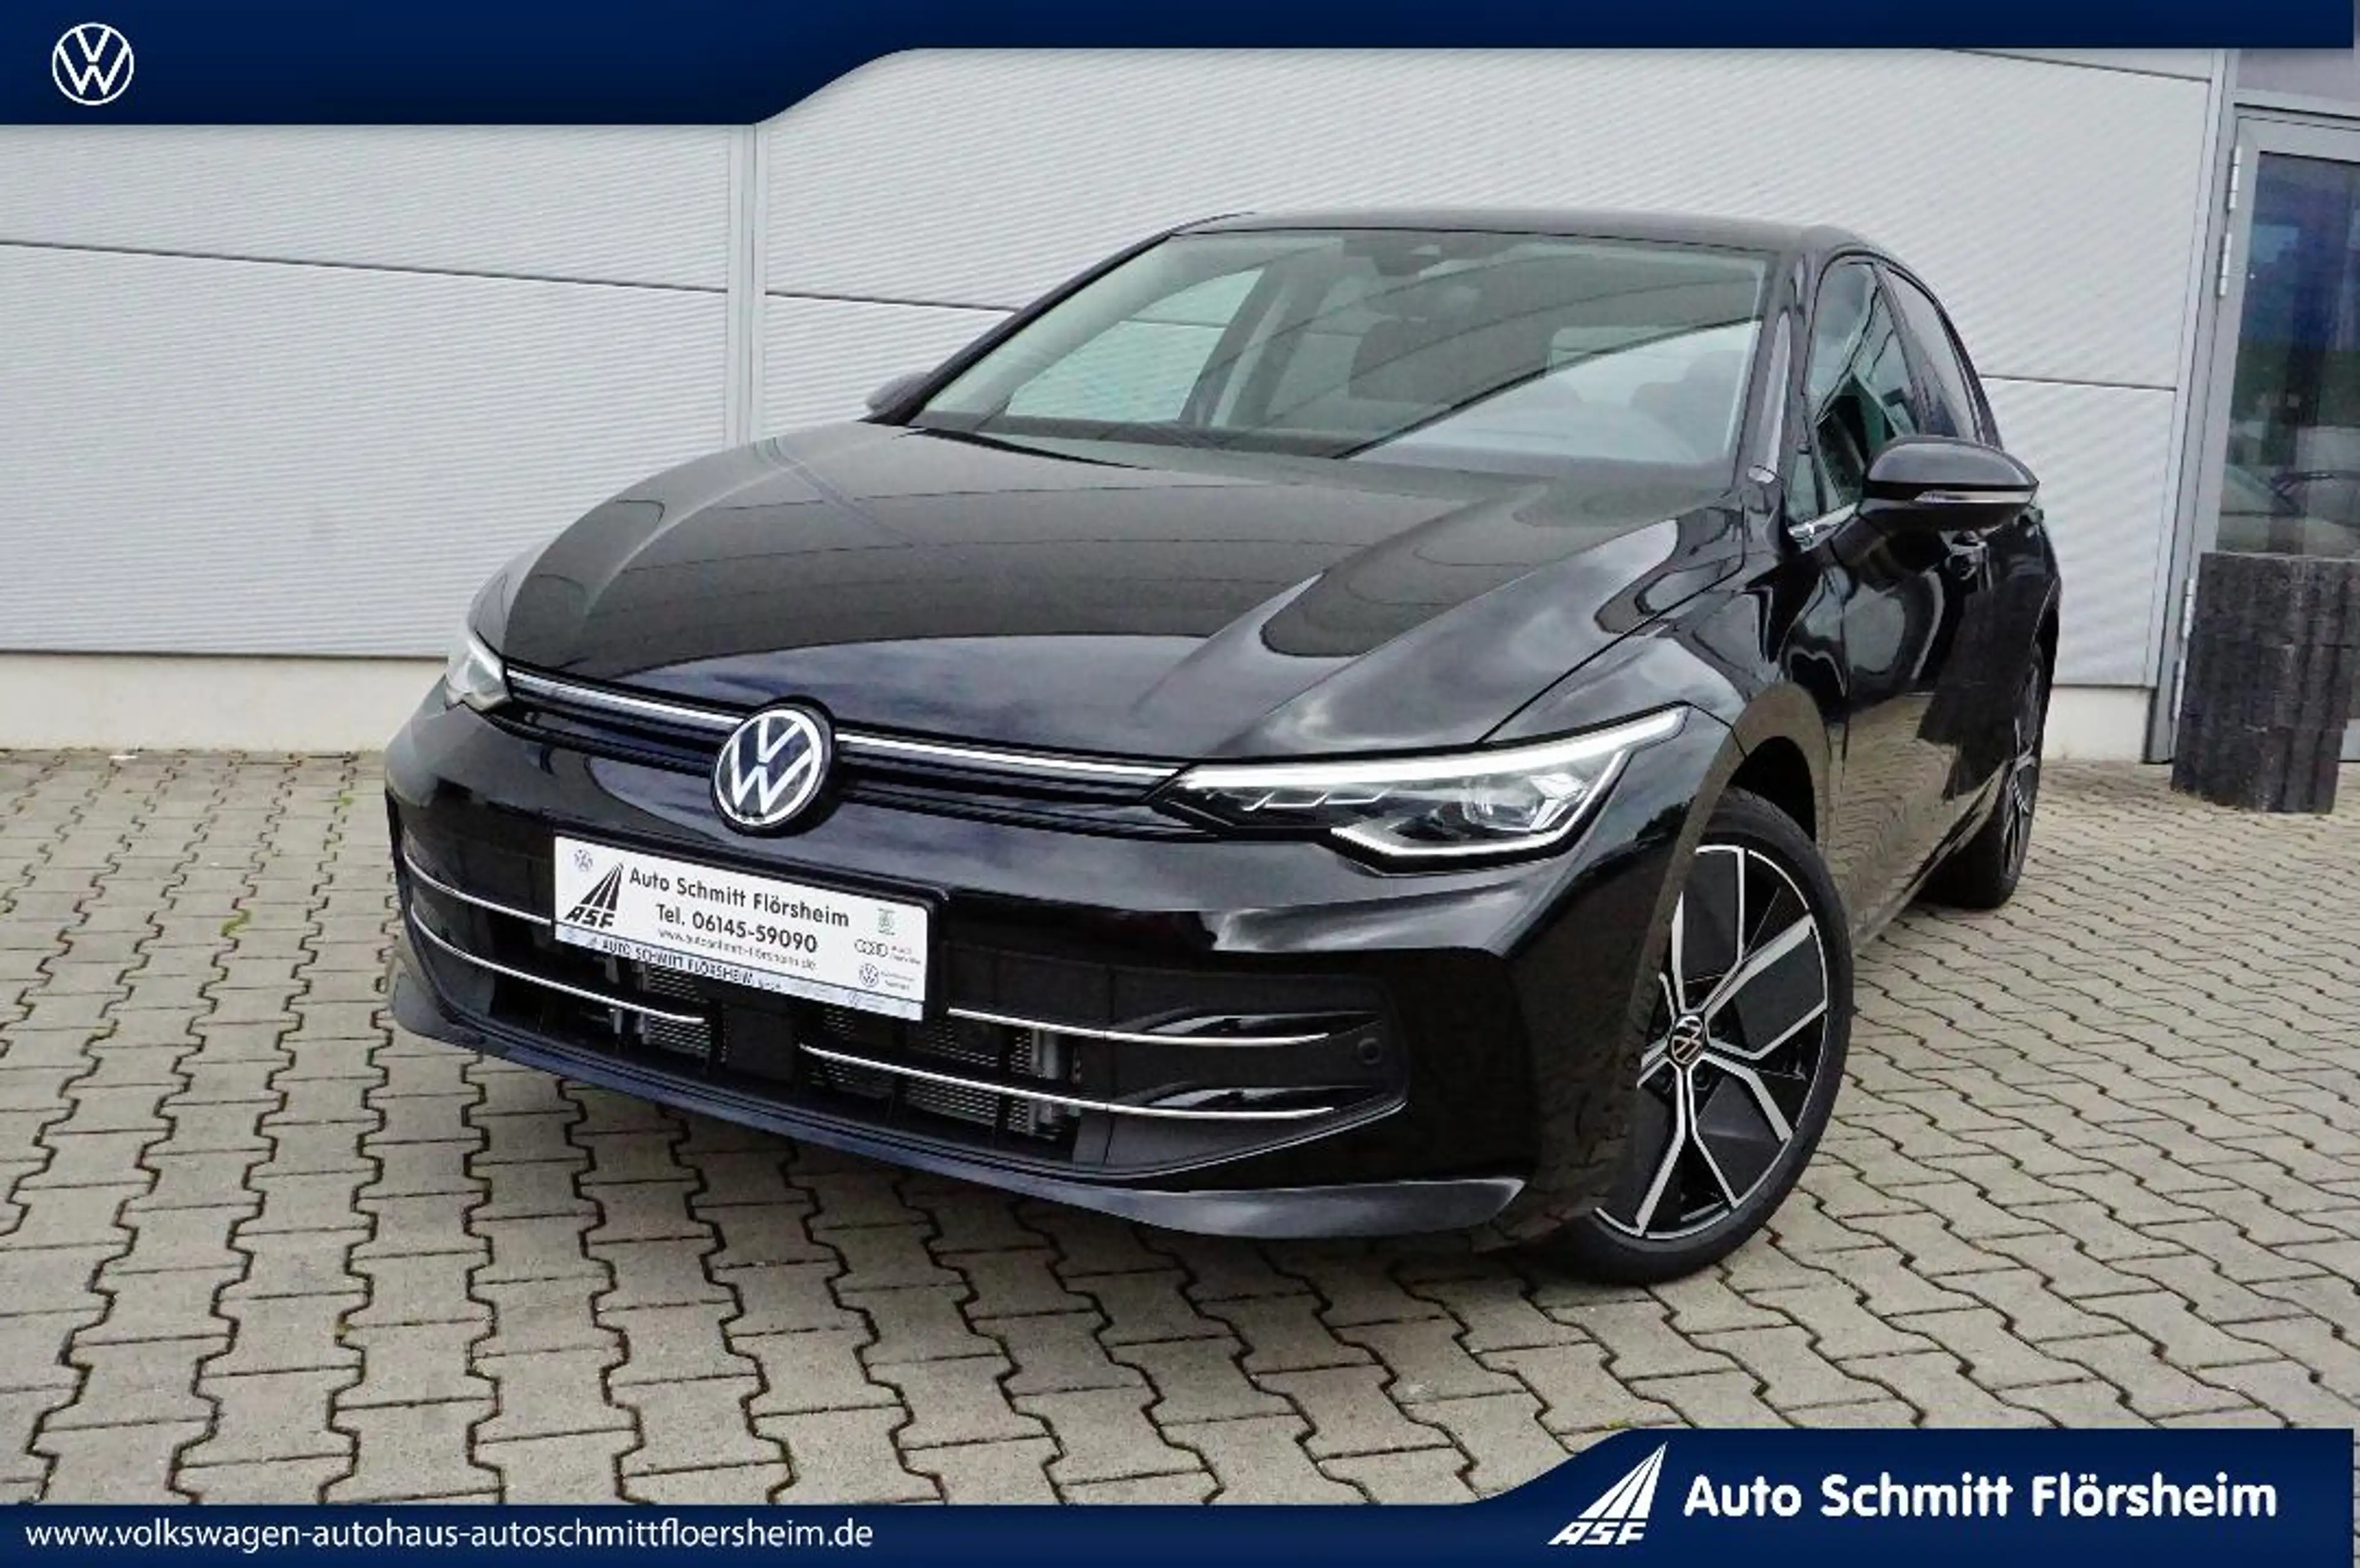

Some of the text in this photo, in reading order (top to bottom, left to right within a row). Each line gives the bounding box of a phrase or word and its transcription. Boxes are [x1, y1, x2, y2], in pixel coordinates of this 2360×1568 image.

[629, 868, 669, 892] Auto
[677, 878, 746, 907] Schmitt
[753, 893, 849, 927] Flörsheim
[565, 906, 615, 928] ASF
[657, 904, 685, 925] Tel.
[693, 912, 817, 952] 06145-59090
[602, 939, 631, 956] AUTO
